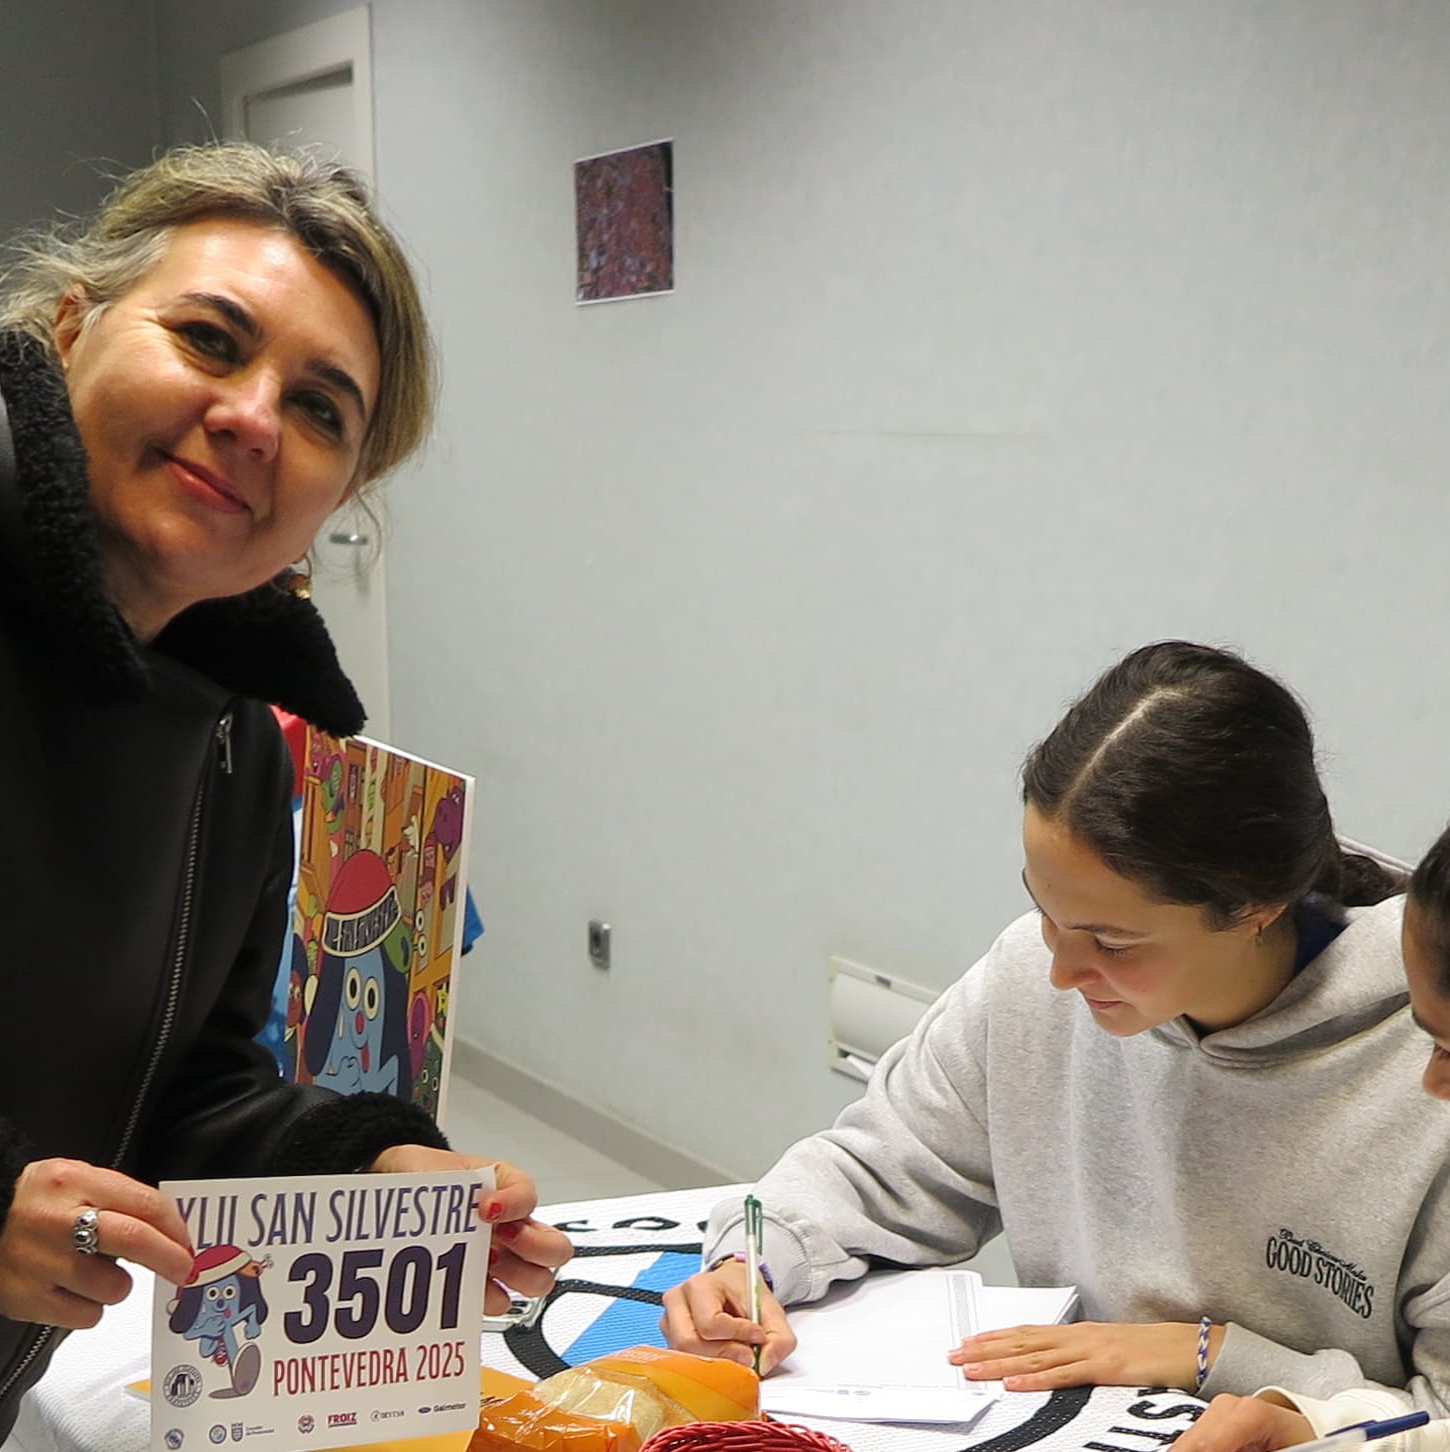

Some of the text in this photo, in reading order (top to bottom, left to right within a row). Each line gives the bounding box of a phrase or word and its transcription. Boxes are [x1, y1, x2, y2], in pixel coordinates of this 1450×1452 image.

[247, 1189, 318, 1248] SAN
[326, 1182, 484, 1244] SILVESTRE
[283, 1242, 469, 1344] 3501
[1266, 1236, 1375, 1319] GOOD STORIES
[273, 1341, 466, 1398] PONTEVEDRA 2025
